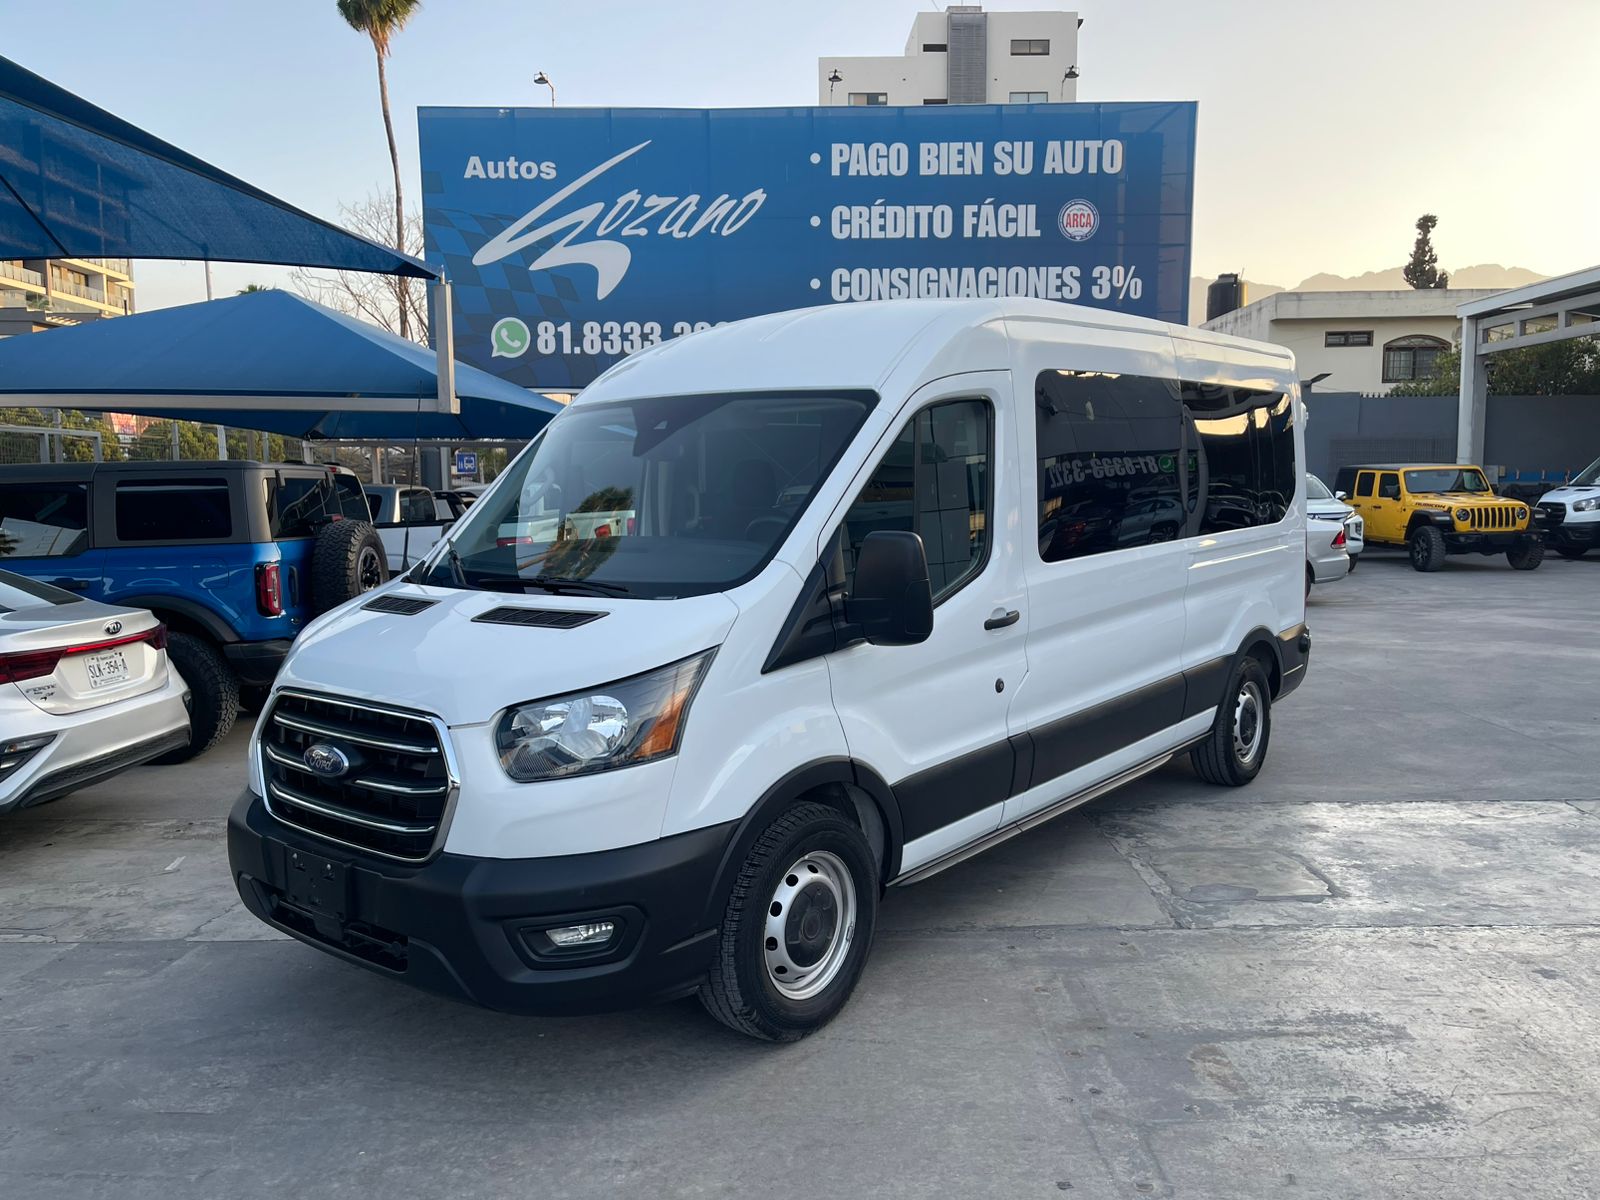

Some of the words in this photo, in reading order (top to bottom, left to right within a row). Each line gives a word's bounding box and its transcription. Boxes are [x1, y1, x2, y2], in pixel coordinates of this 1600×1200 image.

[463, 156, 557, 180] Autos
[831, 142, 909, 176] PAGO
[919, 141, 984, 175] BIEN
[993, 140, 1033, 175] SU
[1043, 138, 1124, 174] AUTO
[831, 198, 953, 239] CRÉDITO
[963, 197, 1041, 238] FÁCIL
[1065, 212, 1092, 228] ARCA
[831, 266, 1081, 301] CONSIGNACIONES
[1091, 265, 1143, 300] 3%
